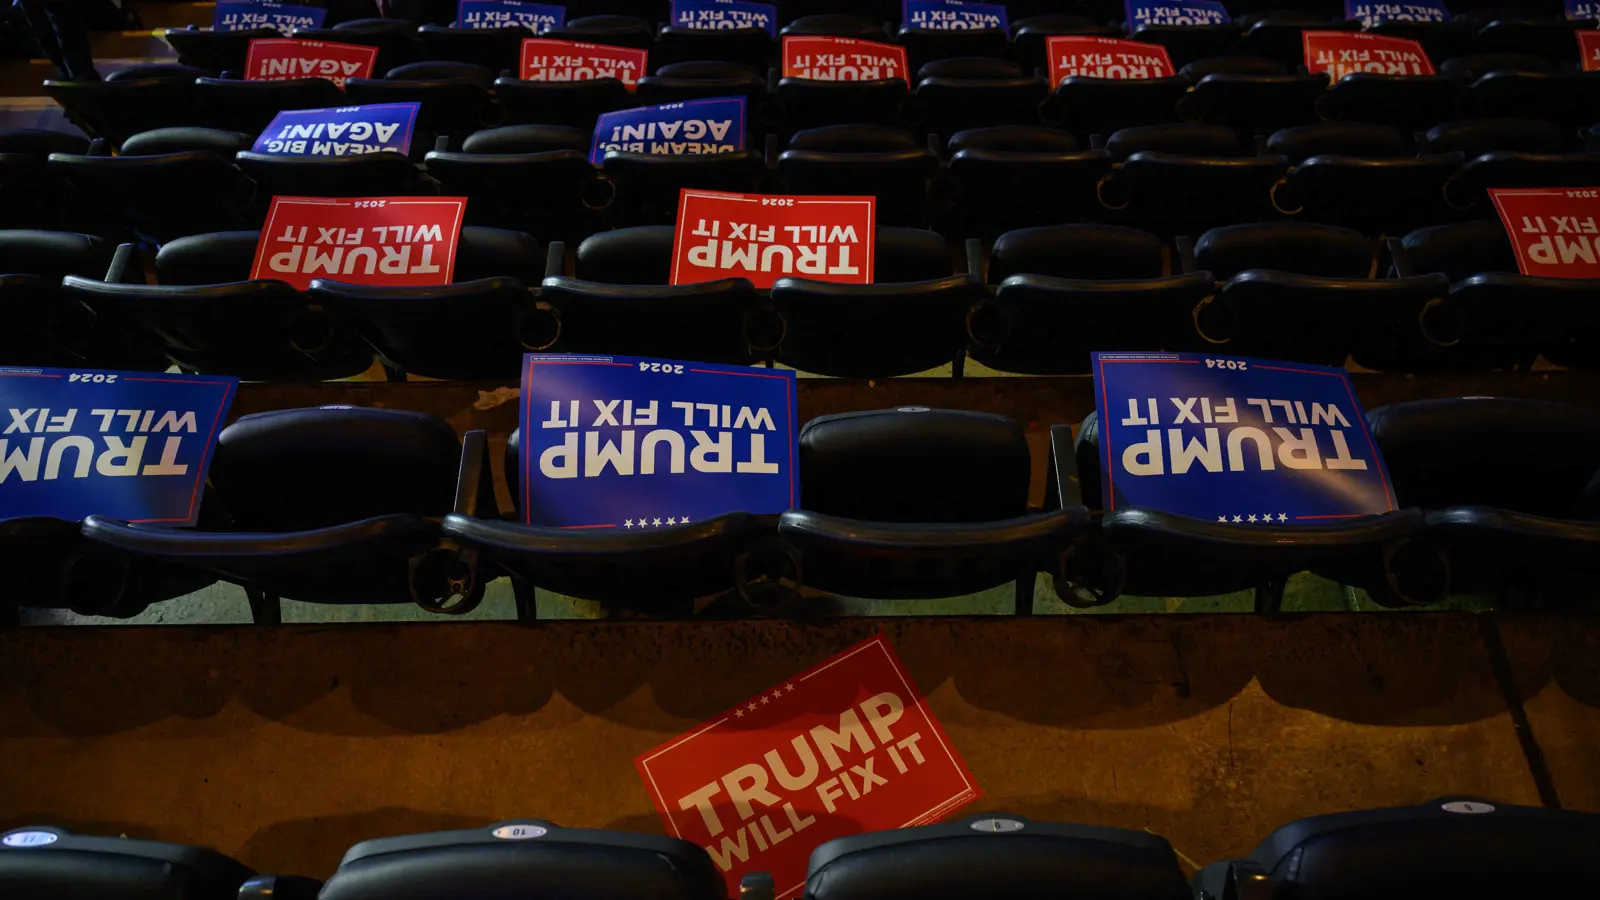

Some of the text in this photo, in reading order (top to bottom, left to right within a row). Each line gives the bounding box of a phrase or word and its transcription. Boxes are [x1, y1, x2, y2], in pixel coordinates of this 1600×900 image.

[464, 11, 556, 24] WILL FIX IT
[679, 10, 769, 22] WILL FIX IT
[911, 11, 1000, 24] WILL FIX IT
[1134, 7, 1223, 19] WILL FIX IT
[1355, 4, 1443, 17] WILL FIX IT
[222, 13, 314, 25] WILL FIX IT
[529, 55, 636, 70] WILL FIX IT
[793, 54, 899, 68] WILL FIX IT
[1059, 53, 1164, 69] WILL FIX IT
[1315, 49, 1422, 65] WILL FIX IT
[260, 57, 362, 76] AGAIN!
[276, 121, 400, 144] AGAIN!
[611, 119, 733, 142] AGAIN!
[263, 138, 308, 154] BIG,
[1566, 190, 1599, 198] 2024
[353, 200, 386, 209] 2024
[761, 198, 794, 207] 2024
[691, 218, 859, 244] WILL FIX IT
[1521, 216, 1599, 234] FIX IT
[276, 224, 443, 245] WILL FIX IT
[268, 244, 440, 275] TRUMP
[687, 238, 859, 275] TRUMP
[638, 361, 685, 375] 2024
[1204, 358, 1248, 371] 2024
[68, 373, 119, 384] 2024
[541, 399, 777, 432] WILL FIX IT
[1121, 397, 1352, 428] WILL FIX IT
[2, 408, 198, 434] WILL FIX
[0, 435, 189, 484] TRUM
[539, 428, 779, 479] TRUMP
[1121, 426, 1368, 477] TRUMP
[677, 691, 905, 838] TRUMP
[704, 802, 817, 873] WILL
[815, 757, 889, 814] FIX
[886, 732, 927, 775] IT
